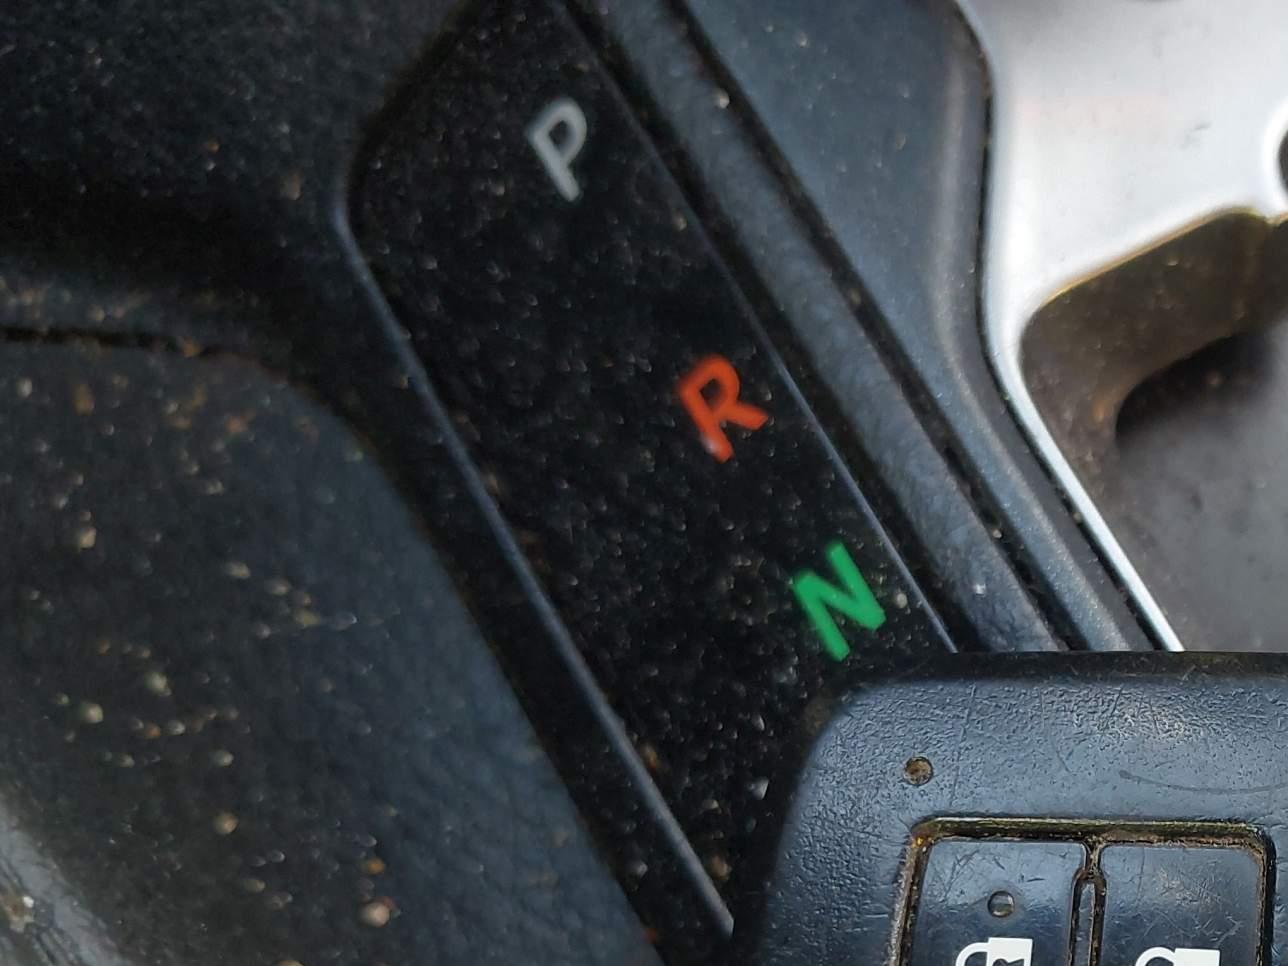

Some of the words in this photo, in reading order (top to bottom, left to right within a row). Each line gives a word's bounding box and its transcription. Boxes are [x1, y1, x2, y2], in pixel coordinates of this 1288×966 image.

[526, 99, 588, 202] P
[678, 353, 769, 463] R
[791, 540, 886, 662] N
